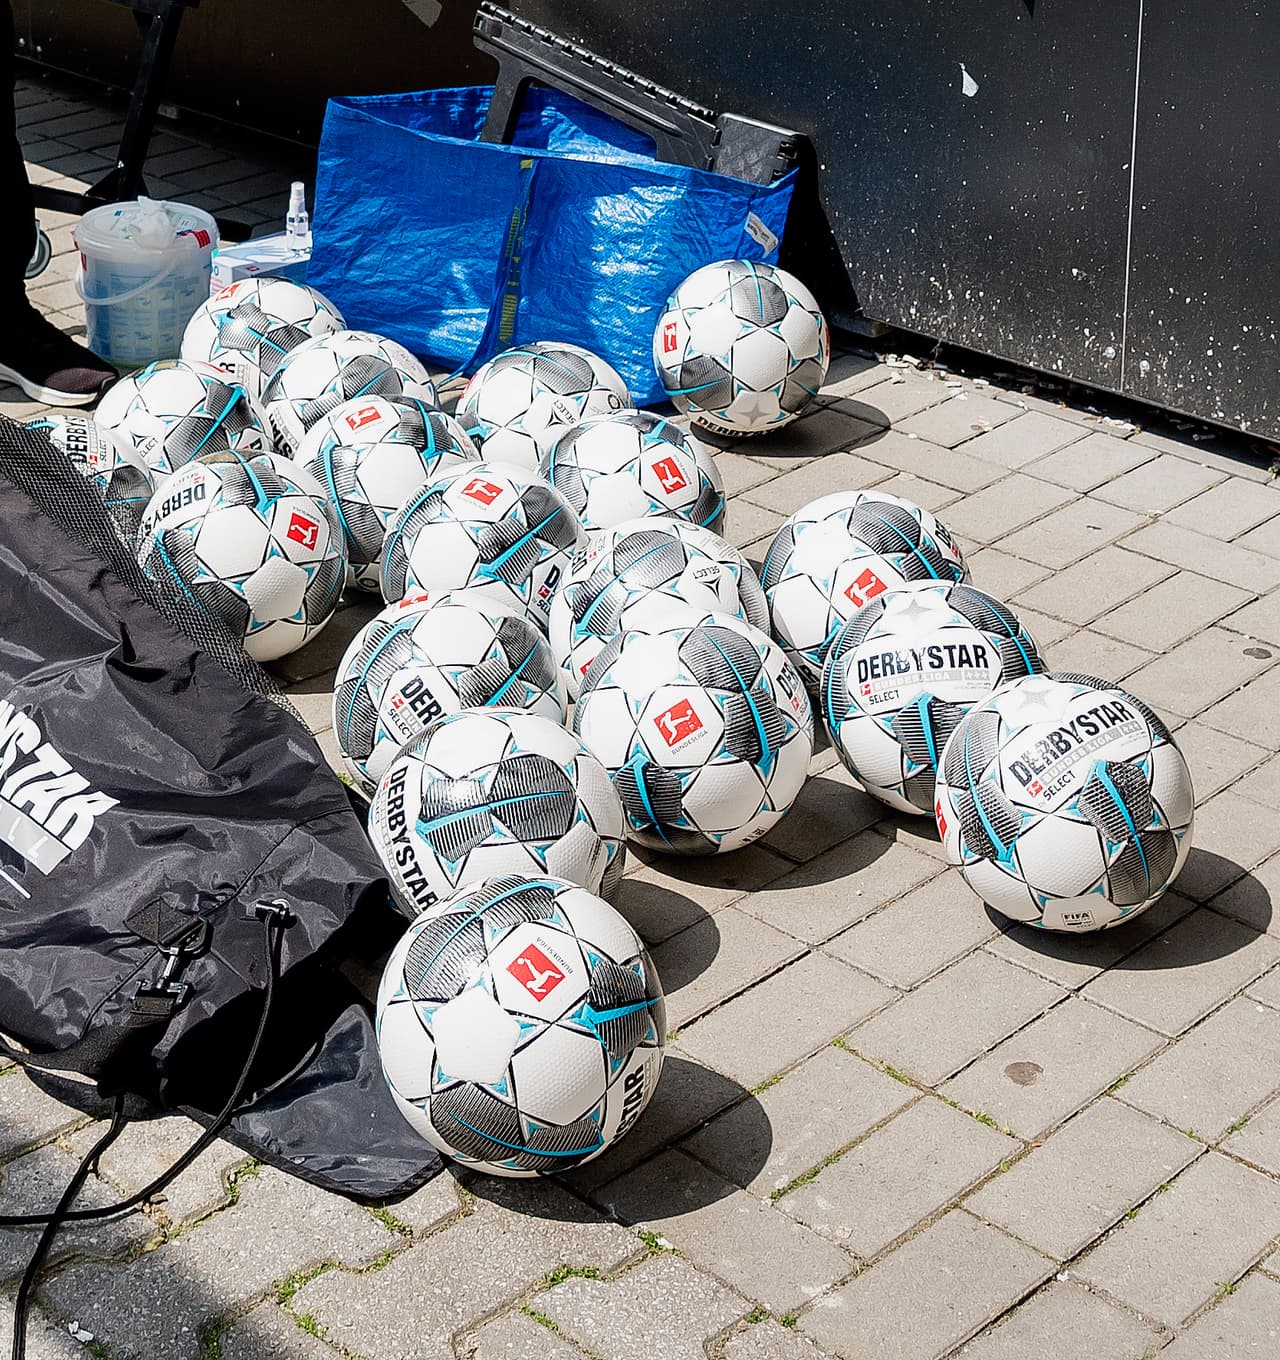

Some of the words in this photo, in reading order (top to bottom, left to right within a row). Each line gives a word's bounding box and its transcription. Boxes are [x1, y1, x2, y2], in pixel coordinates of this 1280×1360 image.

[551, 398, 577, 425] SELECT
[693, 565, 721, 581] SELECT
[857, 643, 989, 684] DERBYSTAR
[869, 689, 900, 706] SELECT
[387, 708, 413, 740] SELECT
[671, 728, 709, 756] BUNDESLIGA
[1008, 700, 1136, 788] DERBYSTAR
[1042, 771, 1076, 801] SELECT
[387, 765, 440, 911] DERBYSTAR
[535, 936, 574, 976] BUNDESLIGA
